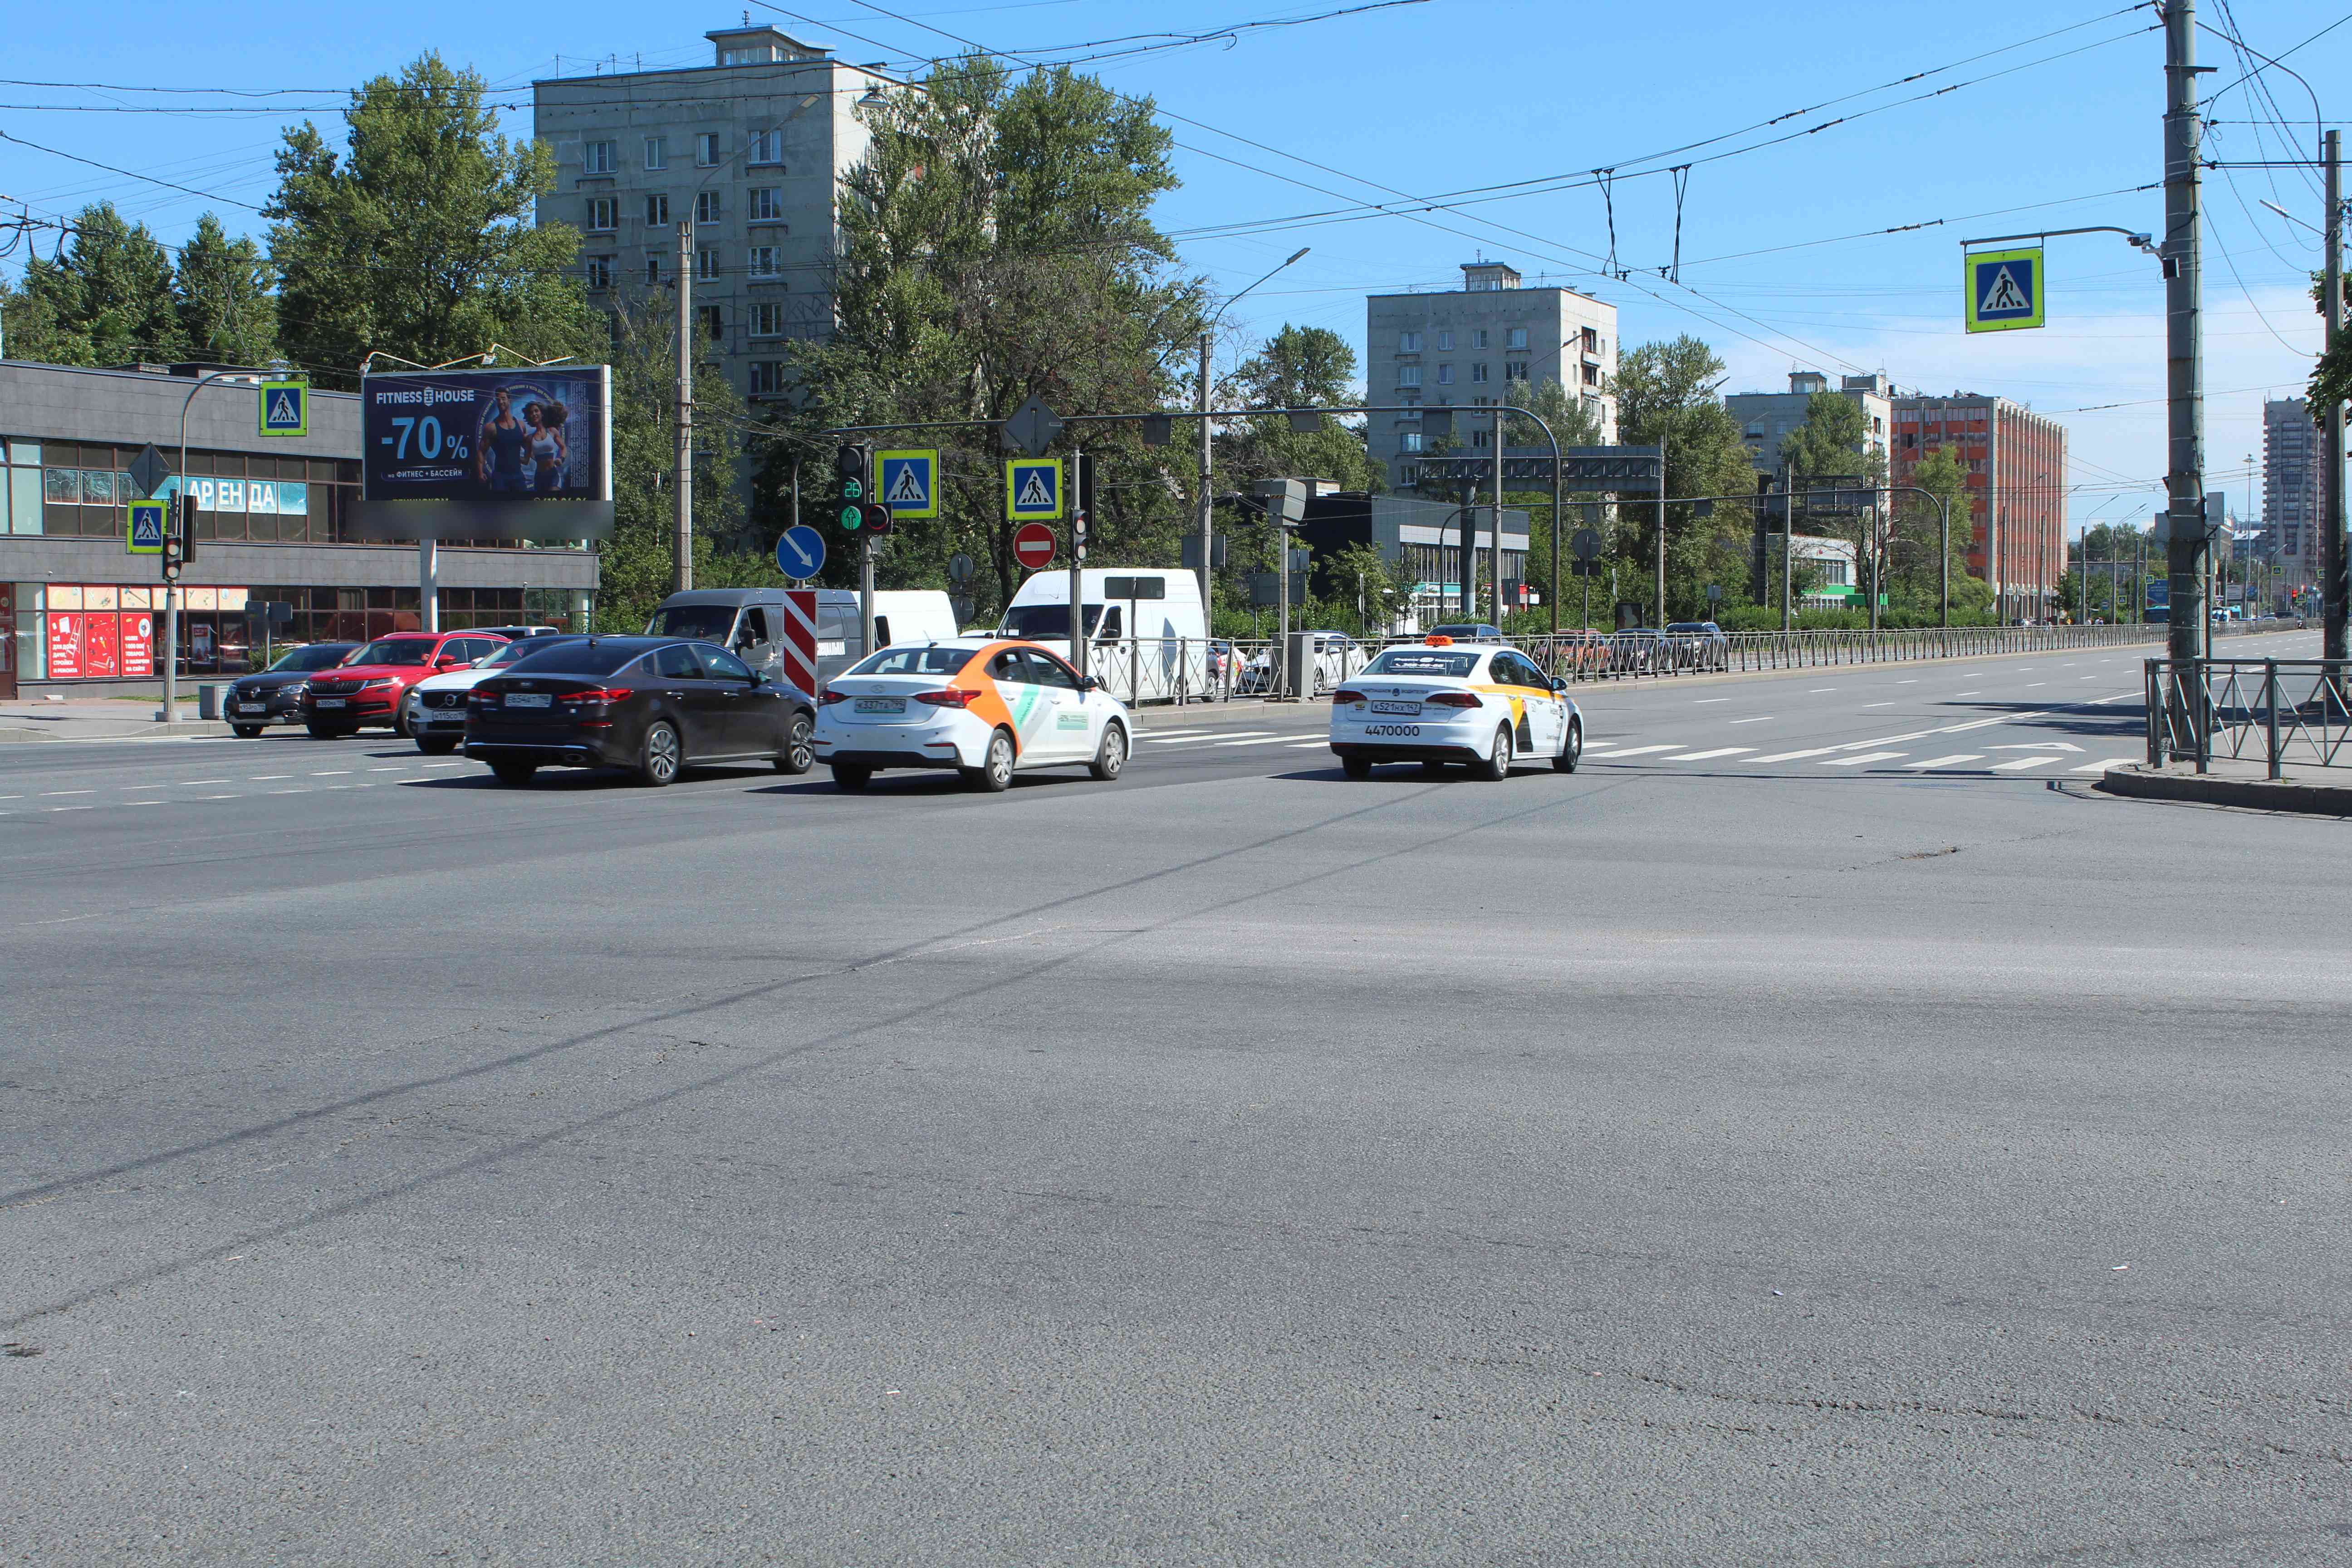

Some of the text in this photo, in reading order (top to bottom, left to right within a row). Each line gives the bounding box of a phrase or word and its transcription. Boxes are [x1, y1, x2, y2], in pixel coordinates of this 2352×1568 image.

[376, 389, 475, 404] FITNESS HOUSE
[430, 468, 463, 476] БАССЕЙН
[189, 480, 275, 510] АРЕНДА
[1365, 725, 1420, 736] 4470000
